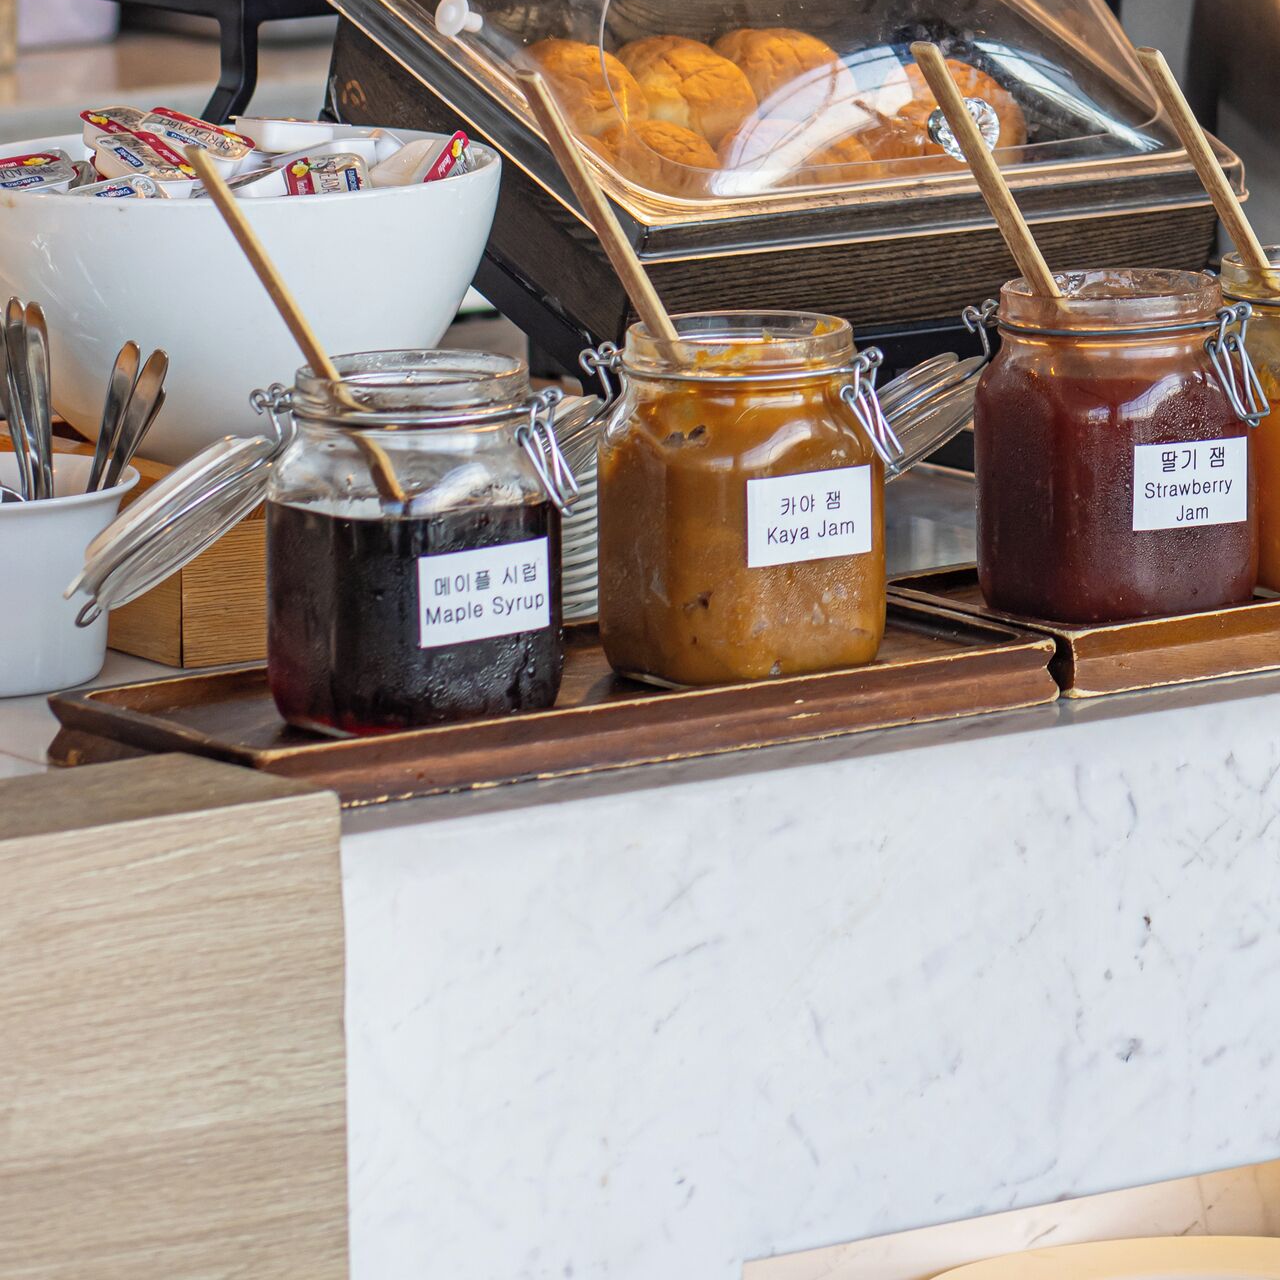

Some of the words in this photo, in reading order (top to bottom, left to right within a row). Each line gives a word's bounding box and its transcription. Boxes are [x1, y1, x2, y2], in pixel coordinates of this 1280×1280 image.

[1161, 449, 1197, 472] 딸기
[1209, 446, 1225, 468] 잼
[1144, 478, 1232, 499] Strawberry
[781, 494, 815, 515] 카야
[825, 490, 841, 510] 잼
[1176, 505, 1209, 522] Jam
[767, 526, 810, 545] Kaya
[817, 519, 855, 538] Jam
[434, 570, 490, 596] 메이플
[502, 562, 537, 584] 시럽
[425, 601, 483, 625] Maple
[492, 593, 545, 616] Syrup
